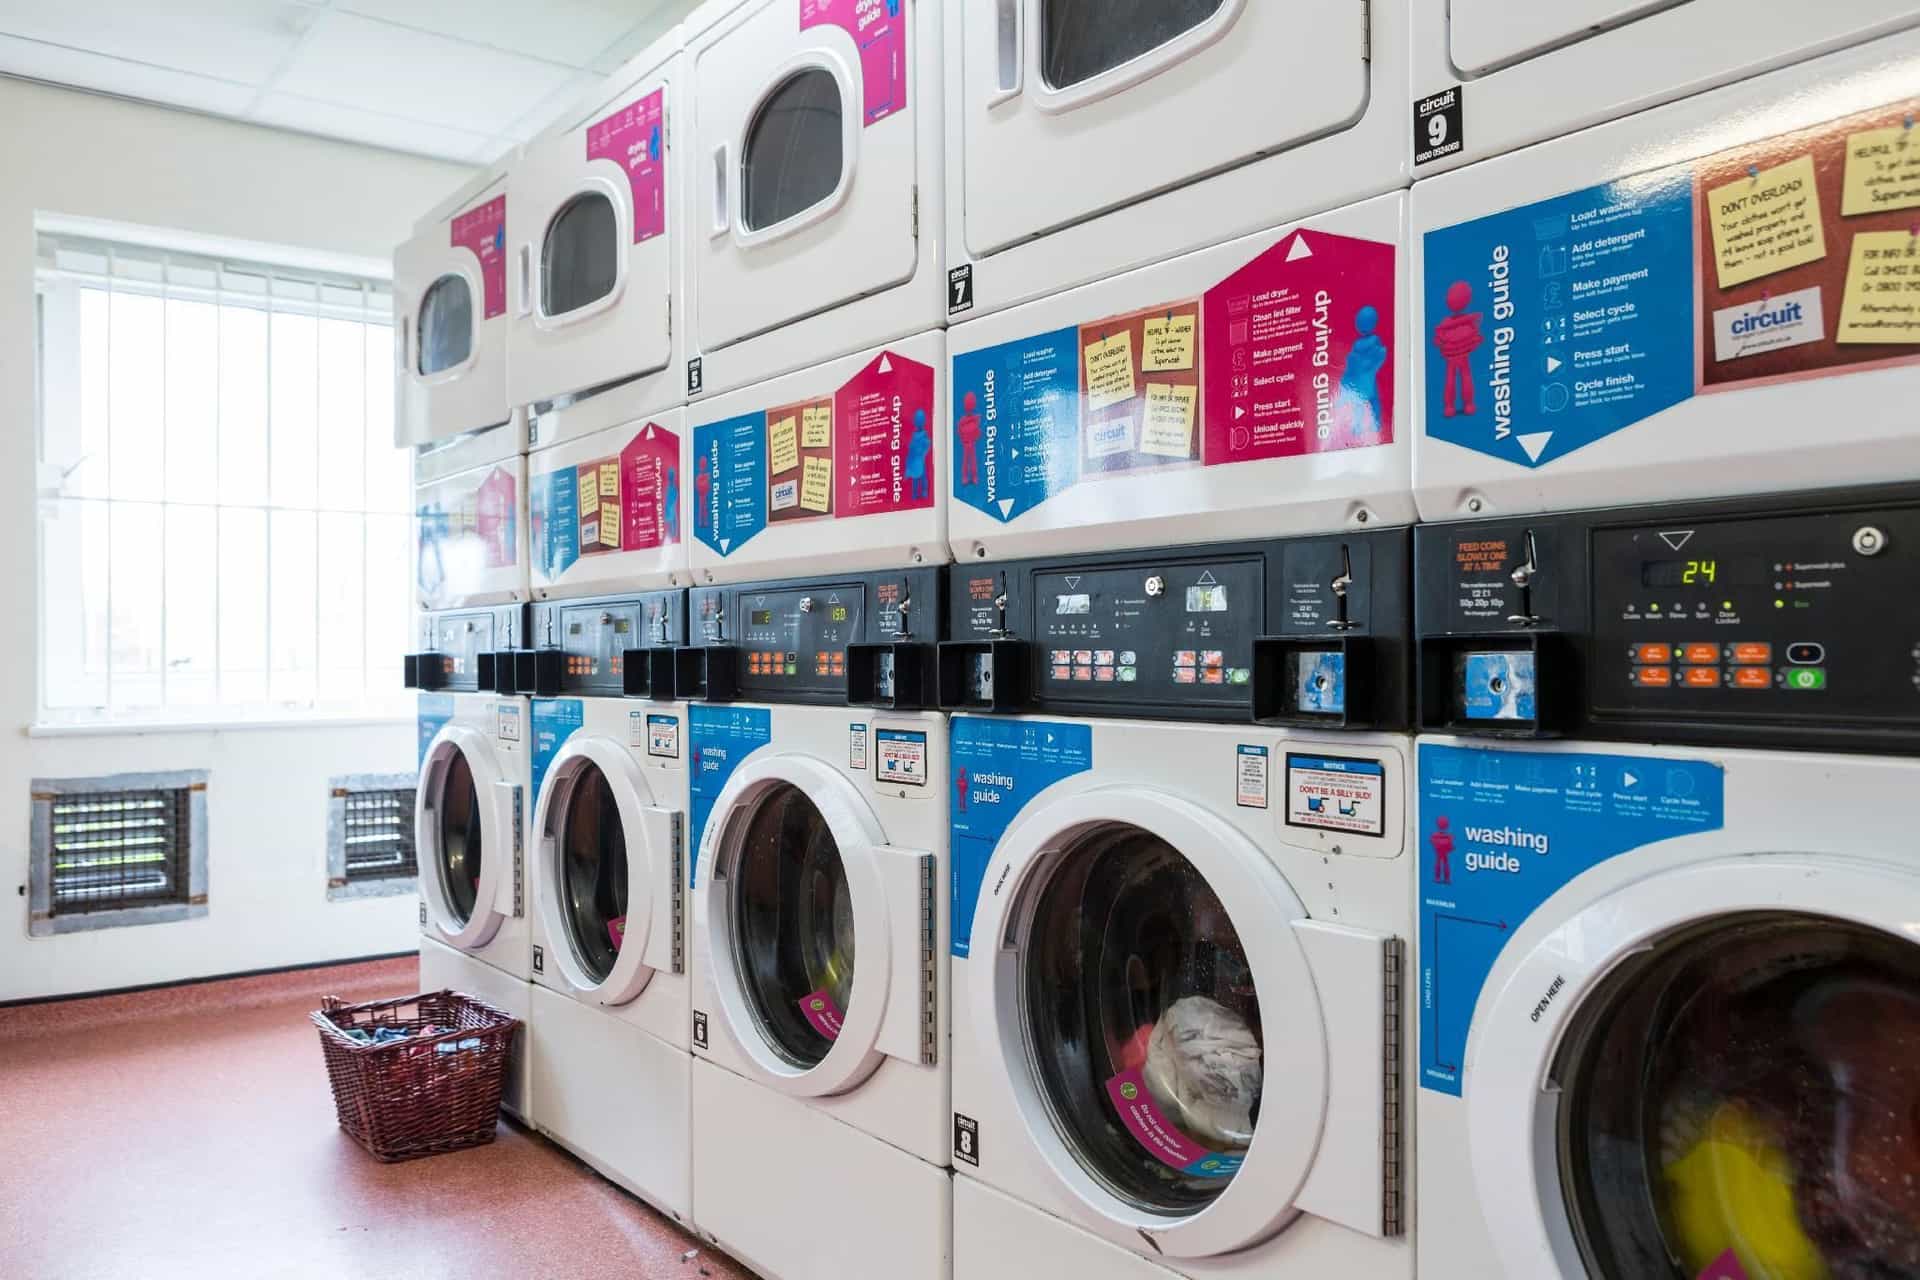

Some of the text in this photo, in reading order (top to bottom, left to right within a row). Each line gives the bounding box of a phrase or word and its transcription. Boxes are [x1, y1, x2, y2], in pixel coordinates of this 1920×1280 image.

[1420, 90, 1455, 113] circuit
[1428, 114, 1448, 147] 9
[1571, 200, 1637, 223] Load washer
[1721, 196, 1748, 216] DON'T
[1720, 220, 1739, 231] Your
[1741, 211, 1768, 225] clothes
[1727, 226, 1754, 243] washed
[1756, 218, 1787, 235] properly
[1572, 228, 1645, 254] Add detergent
[1572, 268, 1648, 293] Make payment
[955, 280, 966, 304] 7
[1252, 294, 1270, 303] Load
[1271, 288, 1289, 299] dryer
[1252, 312, 1272, 322] Clean
[1573, 302, 1636, 323] Select cycle
[1731, 302, 1802, 336] circuit
[1253, 342, 1303, 359] Make payment
[1488, 245, 1515, 441] washing guide
[1574, 344, 1630, 361] Press start
[1312, 290, 1333, 441] drying guide
[691, 370, 698, 388] 5
[1253, 372, 1295, 387] Select cycle
[1575, 374, 1635, 393] Cycle finish
[1253, 399, 1291, 412] Press start
[984, 369, 997, 503] washing guide
[1253, 419, 1305, 434] Unload quickly
[891, 395, 903, 503] drying guide
[711, 440, 720, 541] washing guide
[1683, 561, 1715, 583] 24
[703, 746, 727, 761] washing
[703, 760, 719, 771] guide
[973, 771, 1013, 790] washing
[1299, 785, 1320, 794] DON'T
[1320, 787, 1329, 795] BE
[973, 789, 1000, 804] guide
[1465, 826, 1549, 854] washing
[1465, 851, 1521, 873] guide
[1530, 974, 1566, 1023] OPEN HERE
[697, 1023, 704, 1041] 6
[961, 1130, 972, 1154] 8
